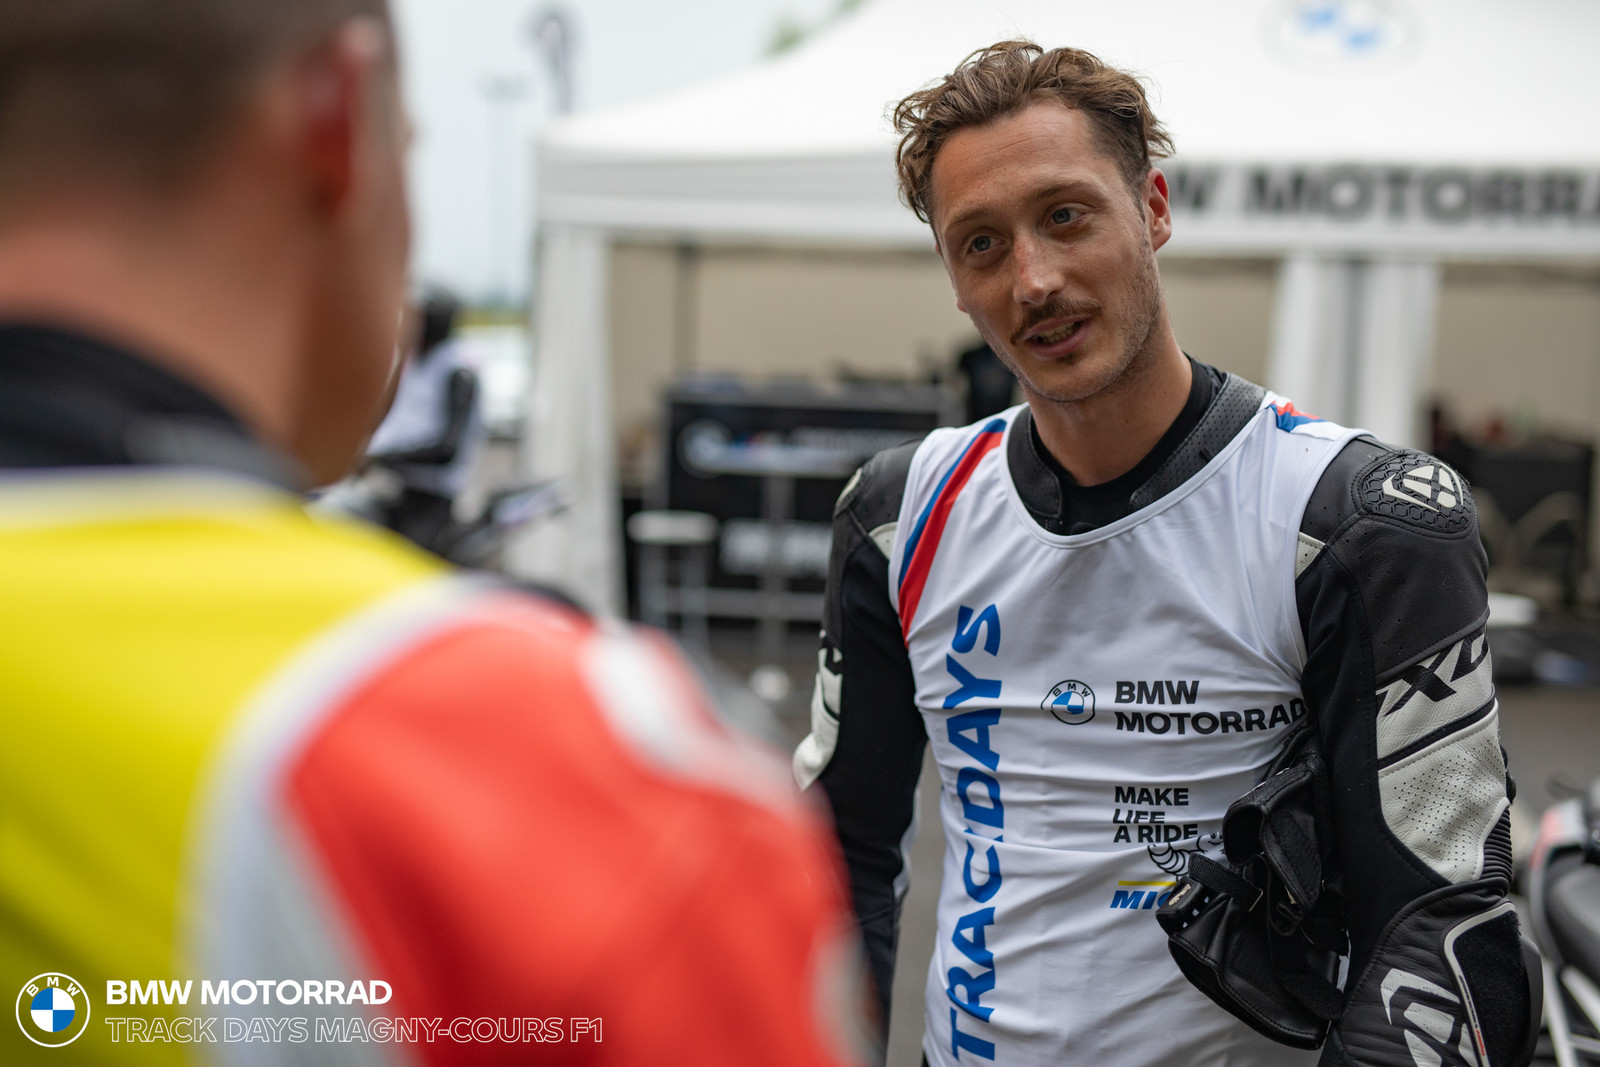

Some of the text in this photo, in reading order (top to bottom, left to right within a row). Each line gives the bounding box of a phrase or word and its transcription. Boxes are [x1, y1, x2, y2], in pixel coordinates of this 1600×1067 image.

[1052, 682, 1091, 698] BMW
[1114, 680, 1200, 705] BMW
[1114, 697, 1307, 735] MOTORRAD
[1114, 786, 1189, 806] MAKE
[1112, 808, 1165, 824] LIFE
[1113, 823, 1198, 843] A RIDE
